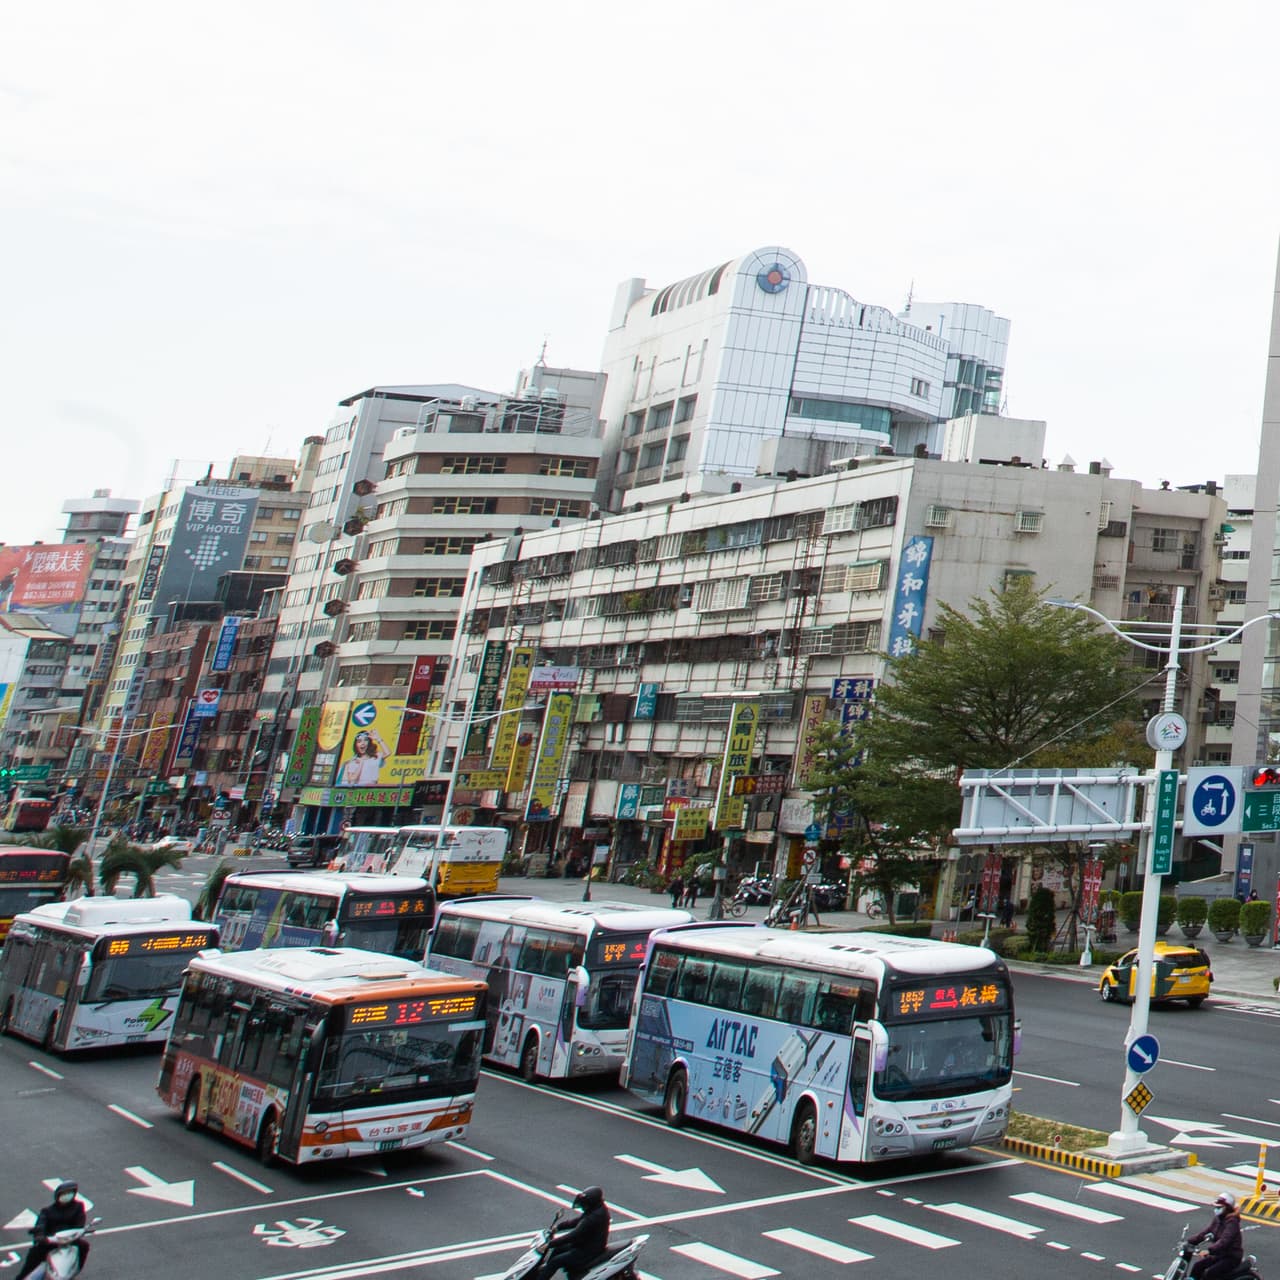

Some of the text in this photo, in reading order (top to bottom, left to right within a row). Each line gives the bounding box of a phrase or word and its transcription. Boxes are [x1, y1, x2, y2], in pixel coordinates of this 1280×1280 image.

[207, 486, 240, 497] HERE!
[189, 500, 247, 525] 博奇
[185, 523, 242, 535] VIP HOTEL
[892, 540, 928, 657] 錦和牙科
[835, 680, 871, 698] 牙科
[1159, 783, 1173, 845] 雙十路一段
[959, 985, 1000, 1007] 板橋
